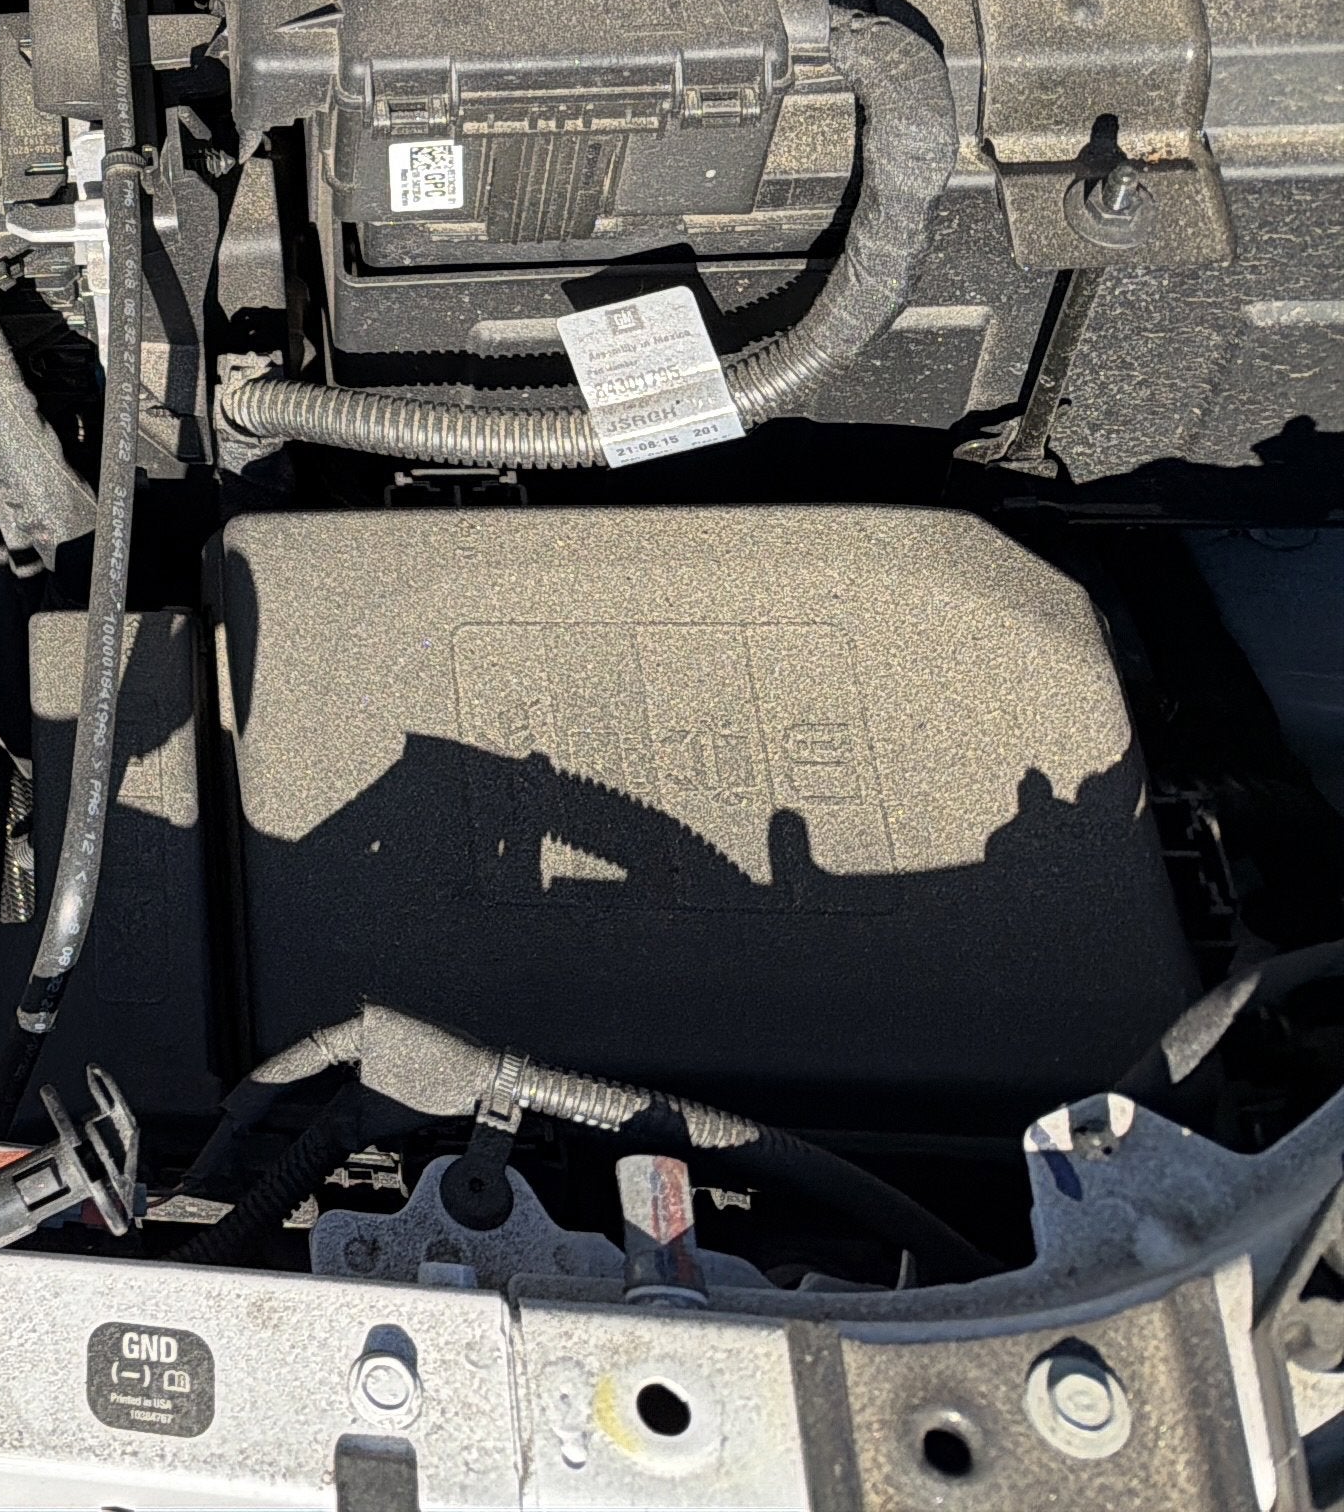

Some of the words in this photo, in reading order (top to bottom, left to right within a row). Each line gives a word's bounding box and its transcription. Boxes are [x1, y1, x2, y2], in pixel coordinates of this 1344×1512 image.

[424, 172, 447, 198] GPC
[614, 310, 635, 327] GM
[615, 434, 680, 458] 21:08:15
[692, 424, 720, 439] 201
[121, 1331, 179, 1364] GND
[110, 1392, 142, 1407] Printed
[153, 1398, 173, 1411] USA
